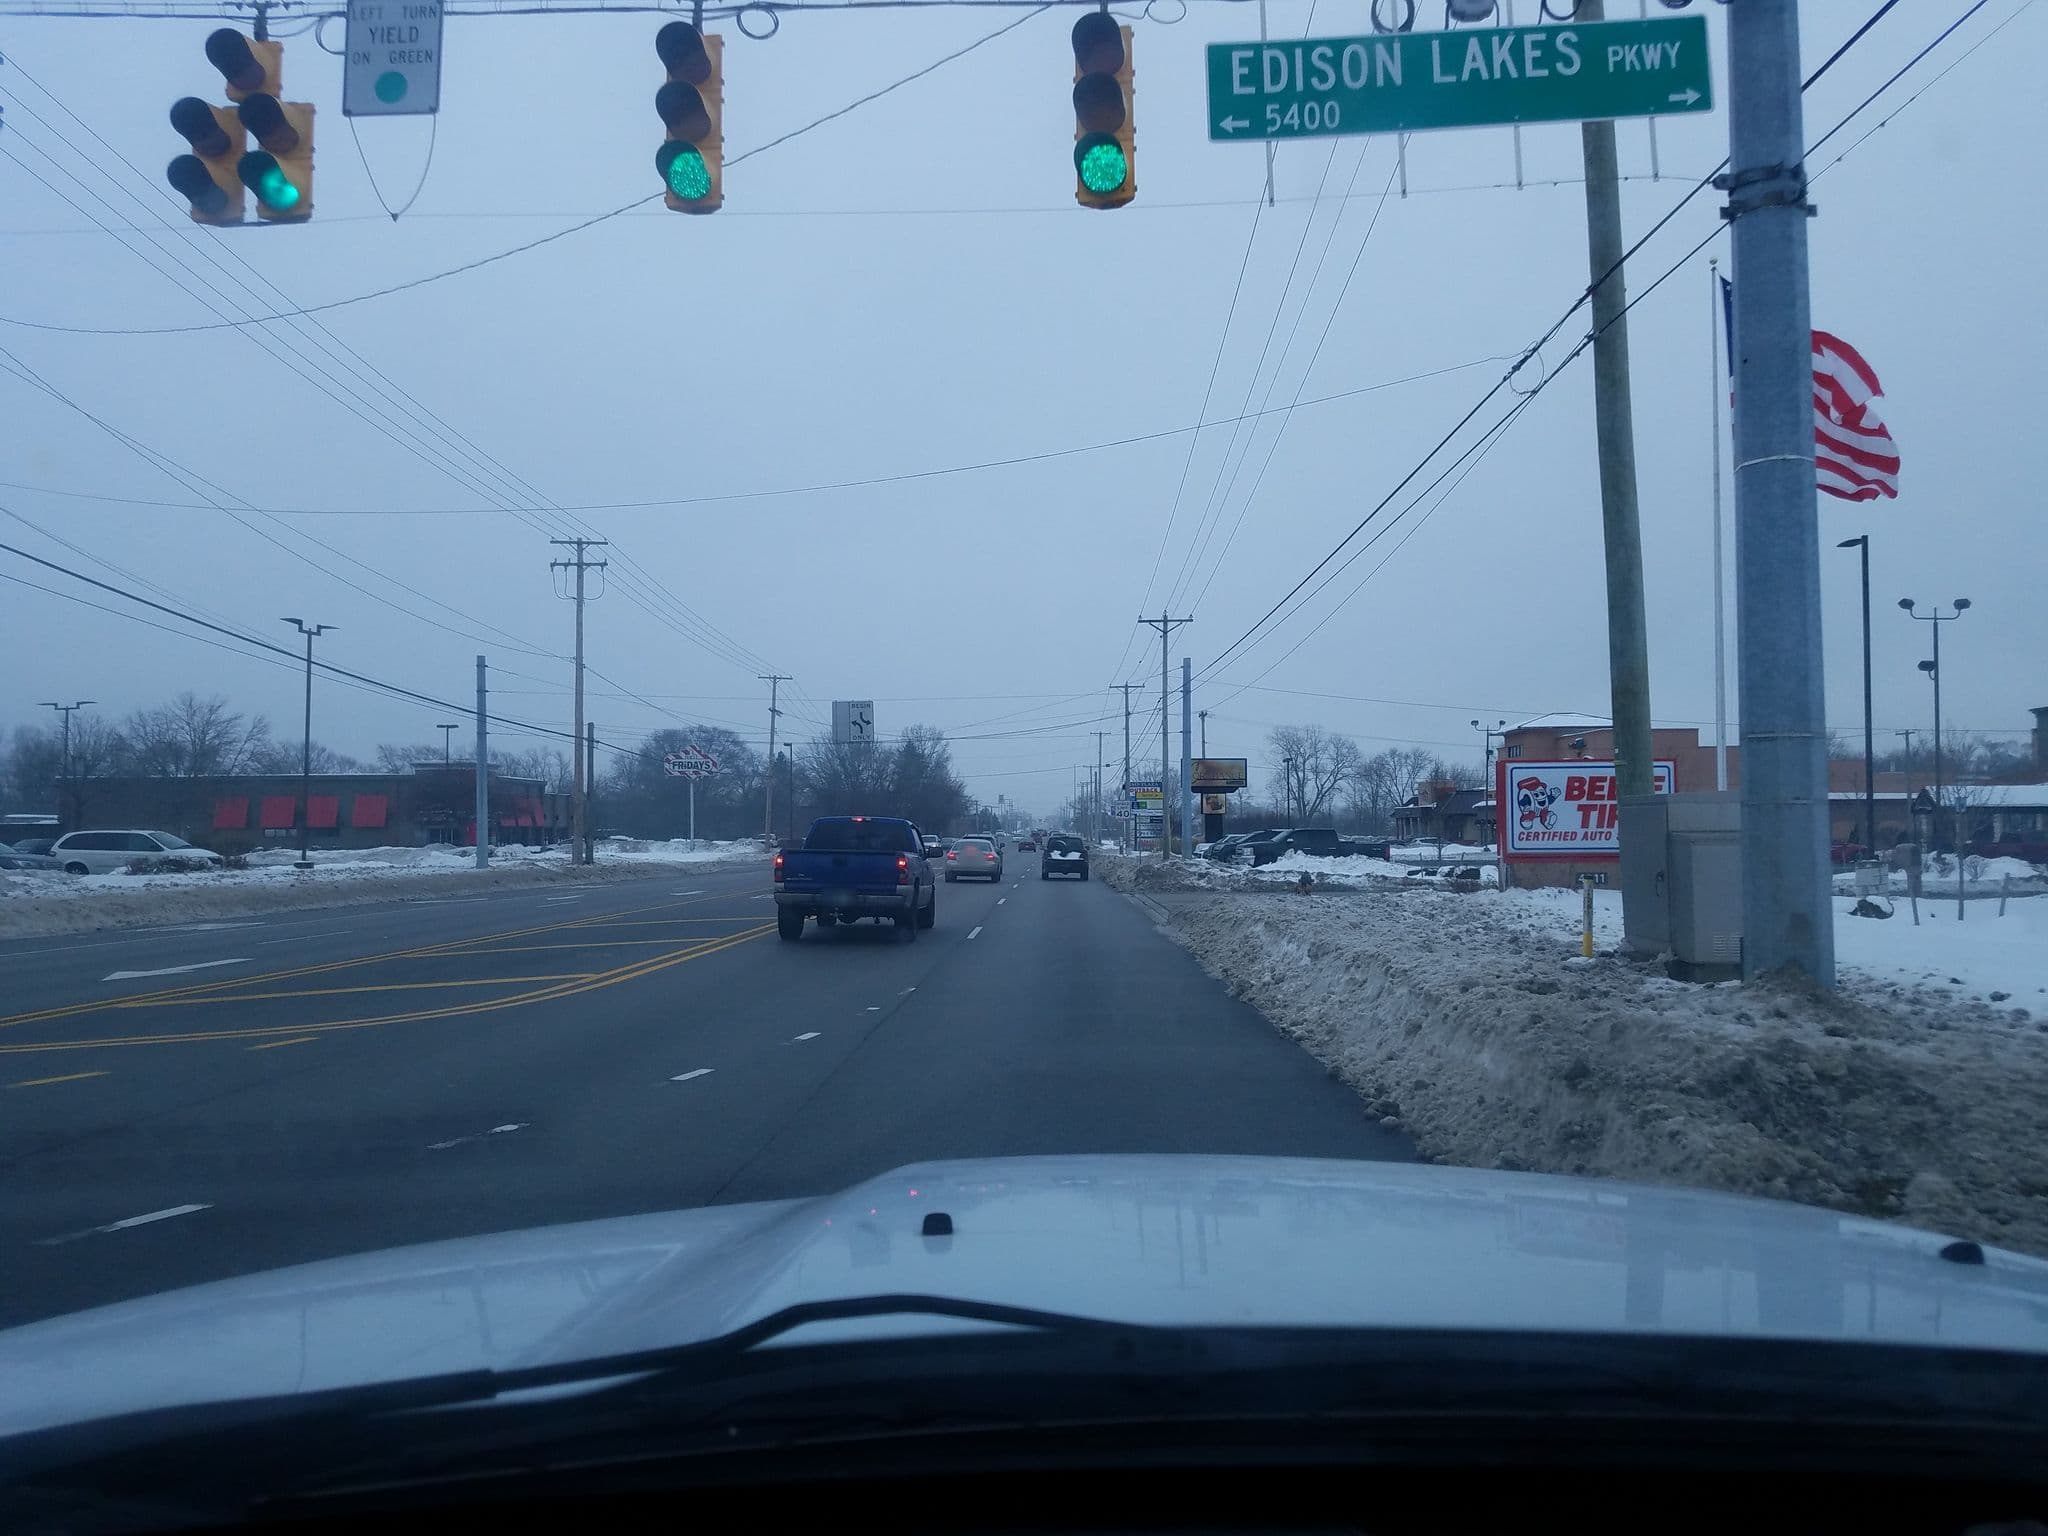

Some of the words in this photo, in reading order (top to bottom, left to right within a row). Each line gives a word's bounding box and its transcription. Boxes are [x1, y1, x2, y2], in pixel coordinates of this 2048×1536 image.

[351, 6, 383, 21] LEFT
[402, 5, 438, 20] TURN
[368, 26, 420, 45] YIELD
[352, 51, 371, 65] ON
[389, 49, 433, 65] GREEN
[1231, 35, 1402, 95] EDISON
[1431, 31, 1582, 84] LAKES
[1607, 40, 1681, 73] PKWY
[1265, 100, 1341, 134] 5400
[672, 760, 711, 770] FRIDAYS
[1116, 810, 1130, 818] 40
[1517, 831, 1578, 842] CERTIFIED
[1581, 830, 1612, 841] AUTO
